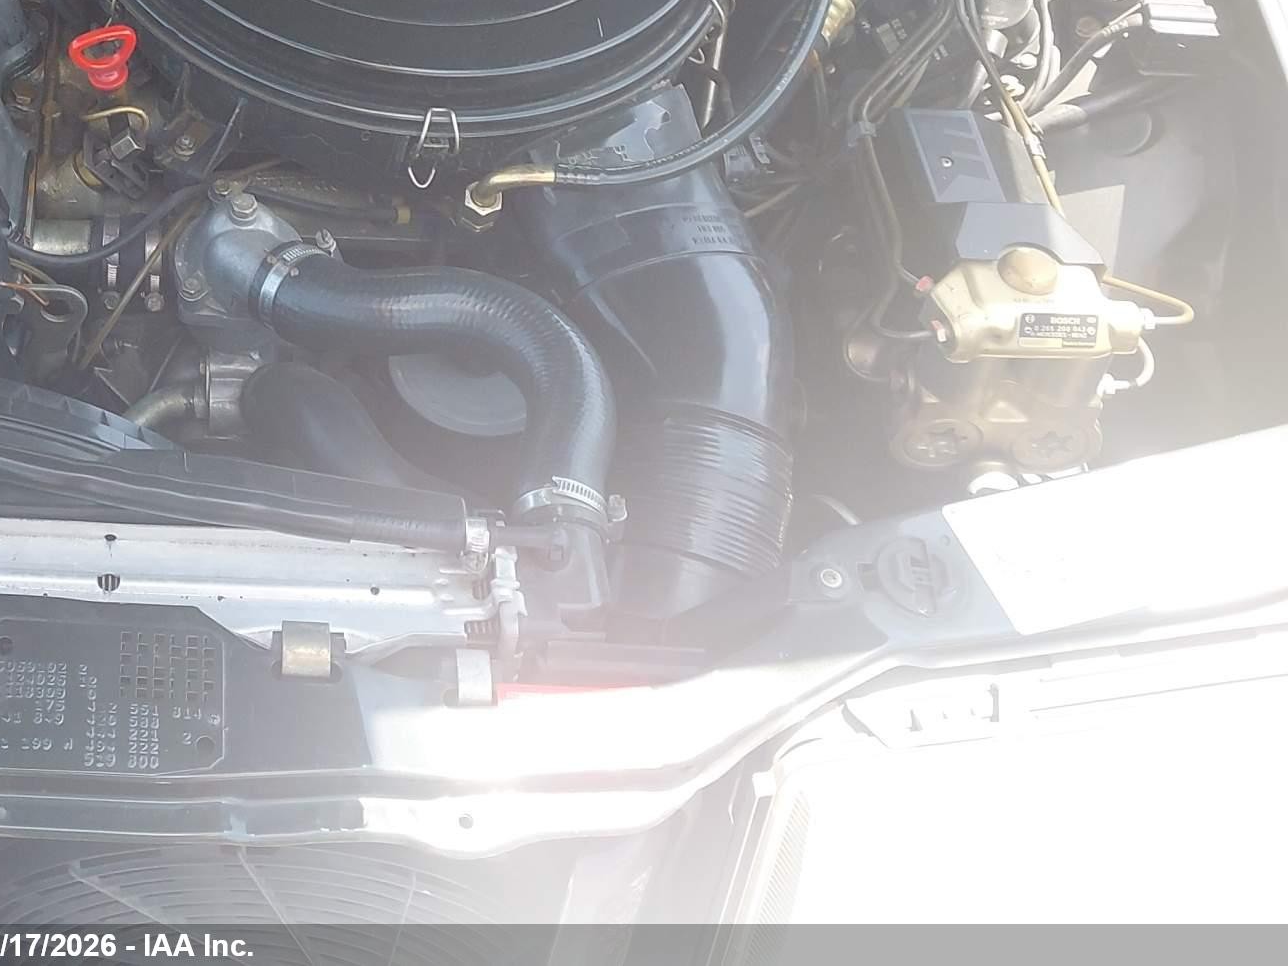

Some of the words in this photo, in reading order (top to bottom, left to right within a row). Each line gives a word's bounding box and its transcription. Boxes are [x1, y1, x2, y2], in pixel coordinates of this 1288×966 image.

[1050, 316, 1080, 325] BOSCH
[130, 703, 159, 716] 551
[129, 729, 159, 742] 221
[182, 732, 191, 744] 2
[129, 742, 159, 754] 222
[128, 755, 159, 769] 800
